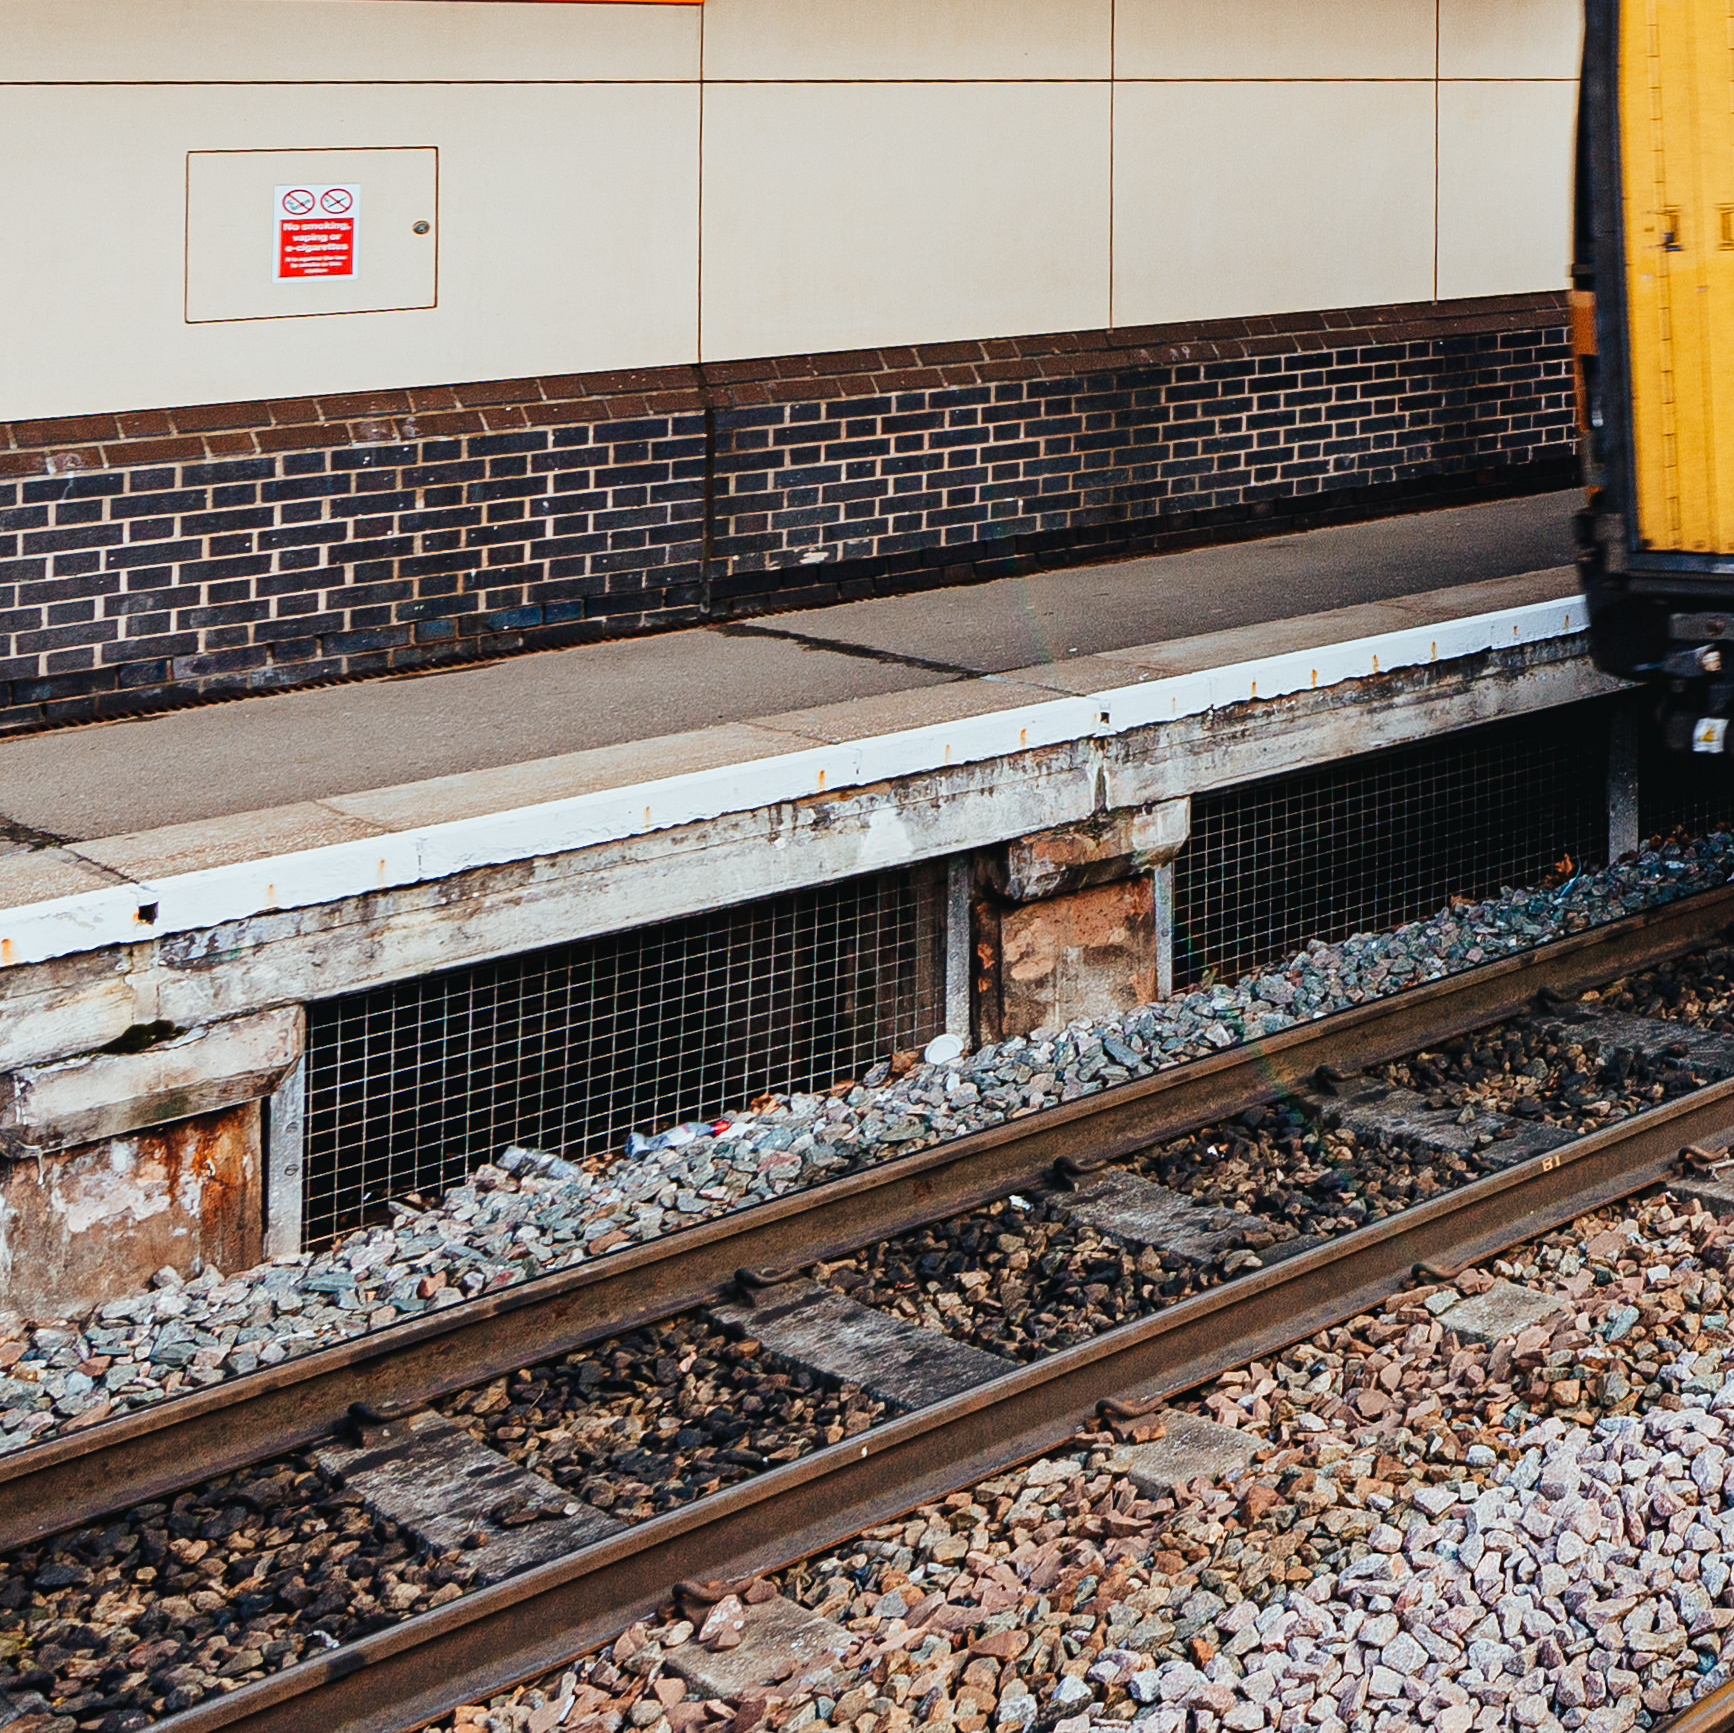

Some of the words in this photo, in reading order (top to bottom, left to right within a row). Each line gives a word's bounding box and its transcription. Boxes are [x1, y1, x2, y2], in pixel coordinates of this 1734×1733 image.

[283, 223, 300, 231] No
[292, 233, 328, 242] vaping
[329, 233, 342, 241] or
